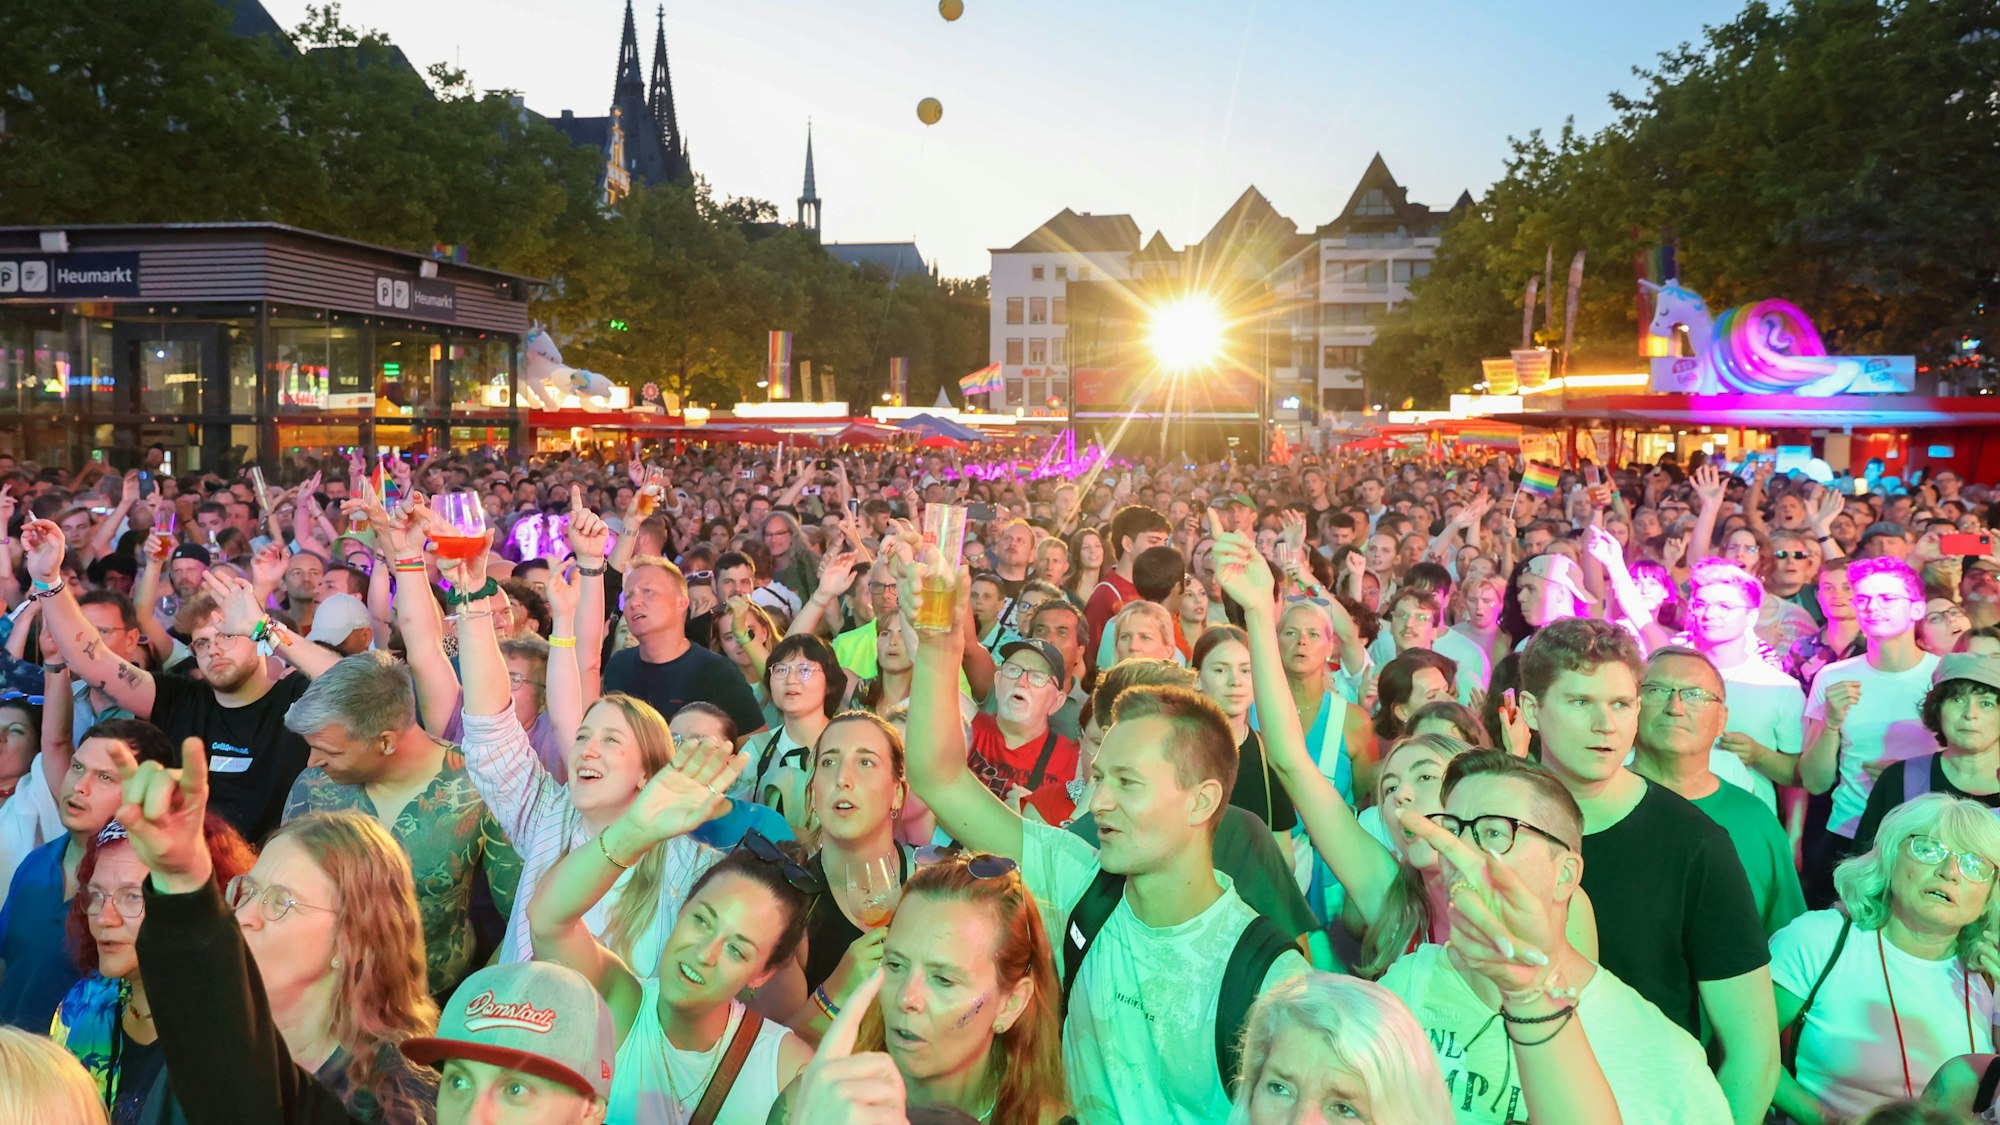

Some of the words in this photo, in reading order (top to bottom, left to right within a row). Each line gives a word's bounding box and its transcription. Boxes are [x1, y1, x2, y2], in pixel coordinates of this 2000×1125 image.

[57, 266, 133, 283] Heumarkt
[414, 291, 453, 309] Heumarkt
[464, 990, 556, 1027] Domstadt
